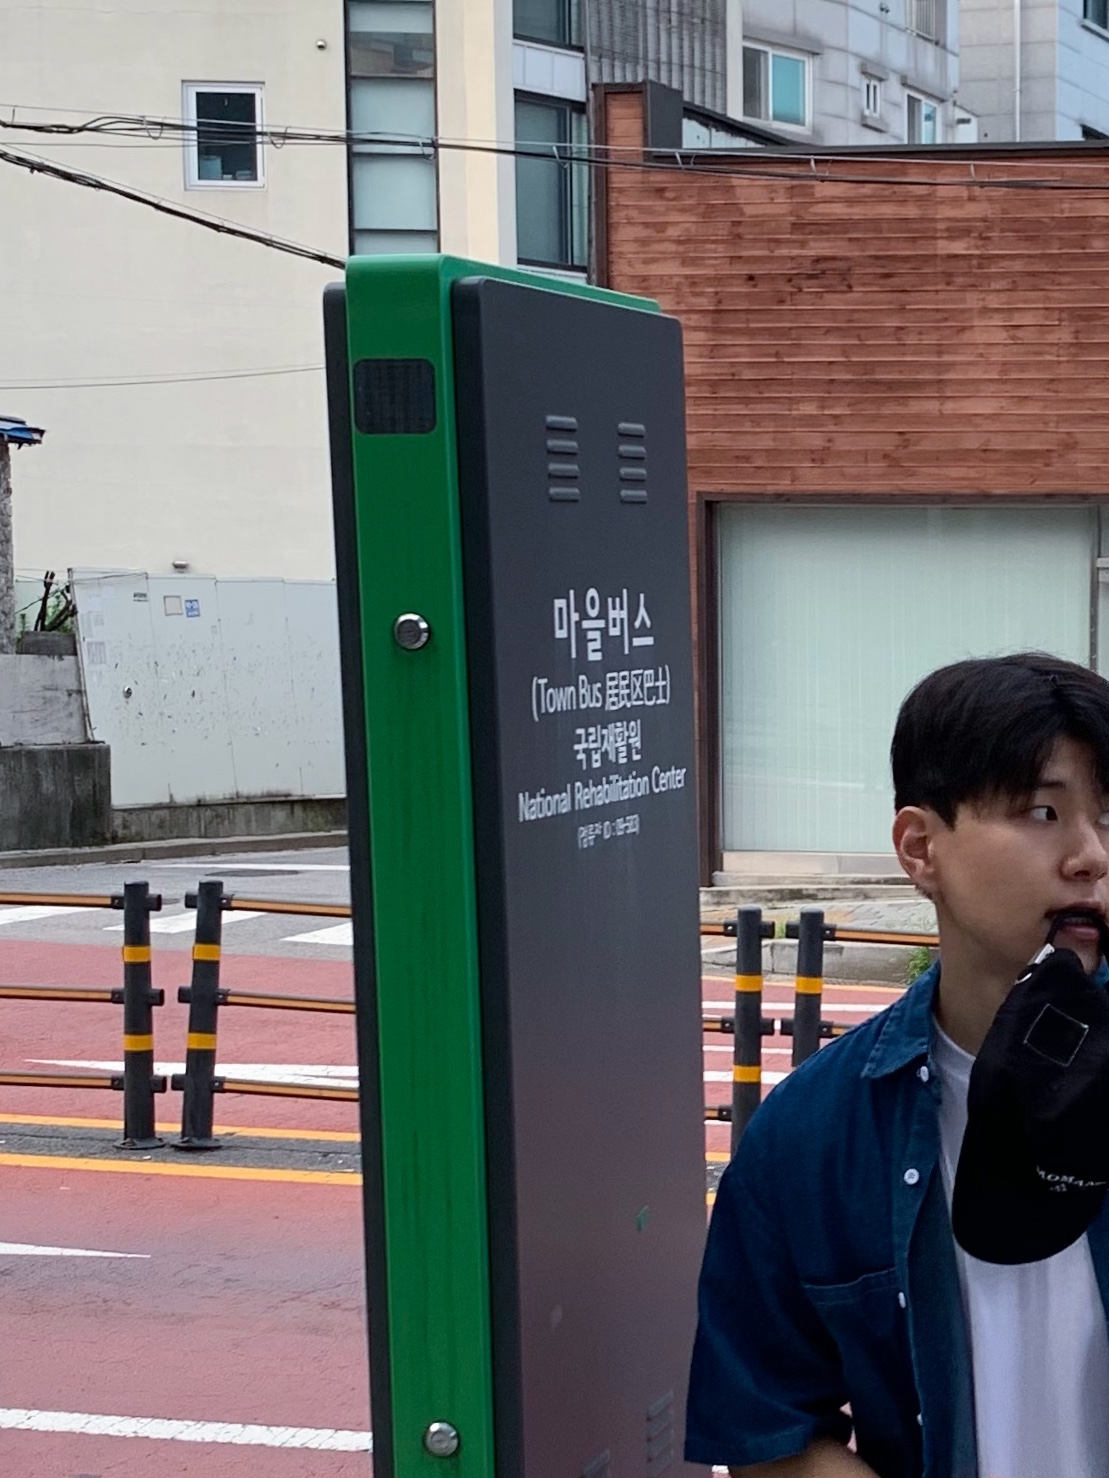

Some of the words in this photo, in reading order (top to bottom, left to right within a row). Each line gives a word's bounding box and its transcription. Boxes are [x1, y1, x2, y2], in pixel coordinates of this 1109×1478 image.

[553, 587, 655, 662] 마을버스
[531, 676, 577, 722] (Town
[579, 674, 602, 709] Bus
[573, 719, 642, 770] 국립재활원
[518, 783, 572, 823] National
[574, 770, 650, 811] Rehabilitation
[651, 765, 687, 794] Center
